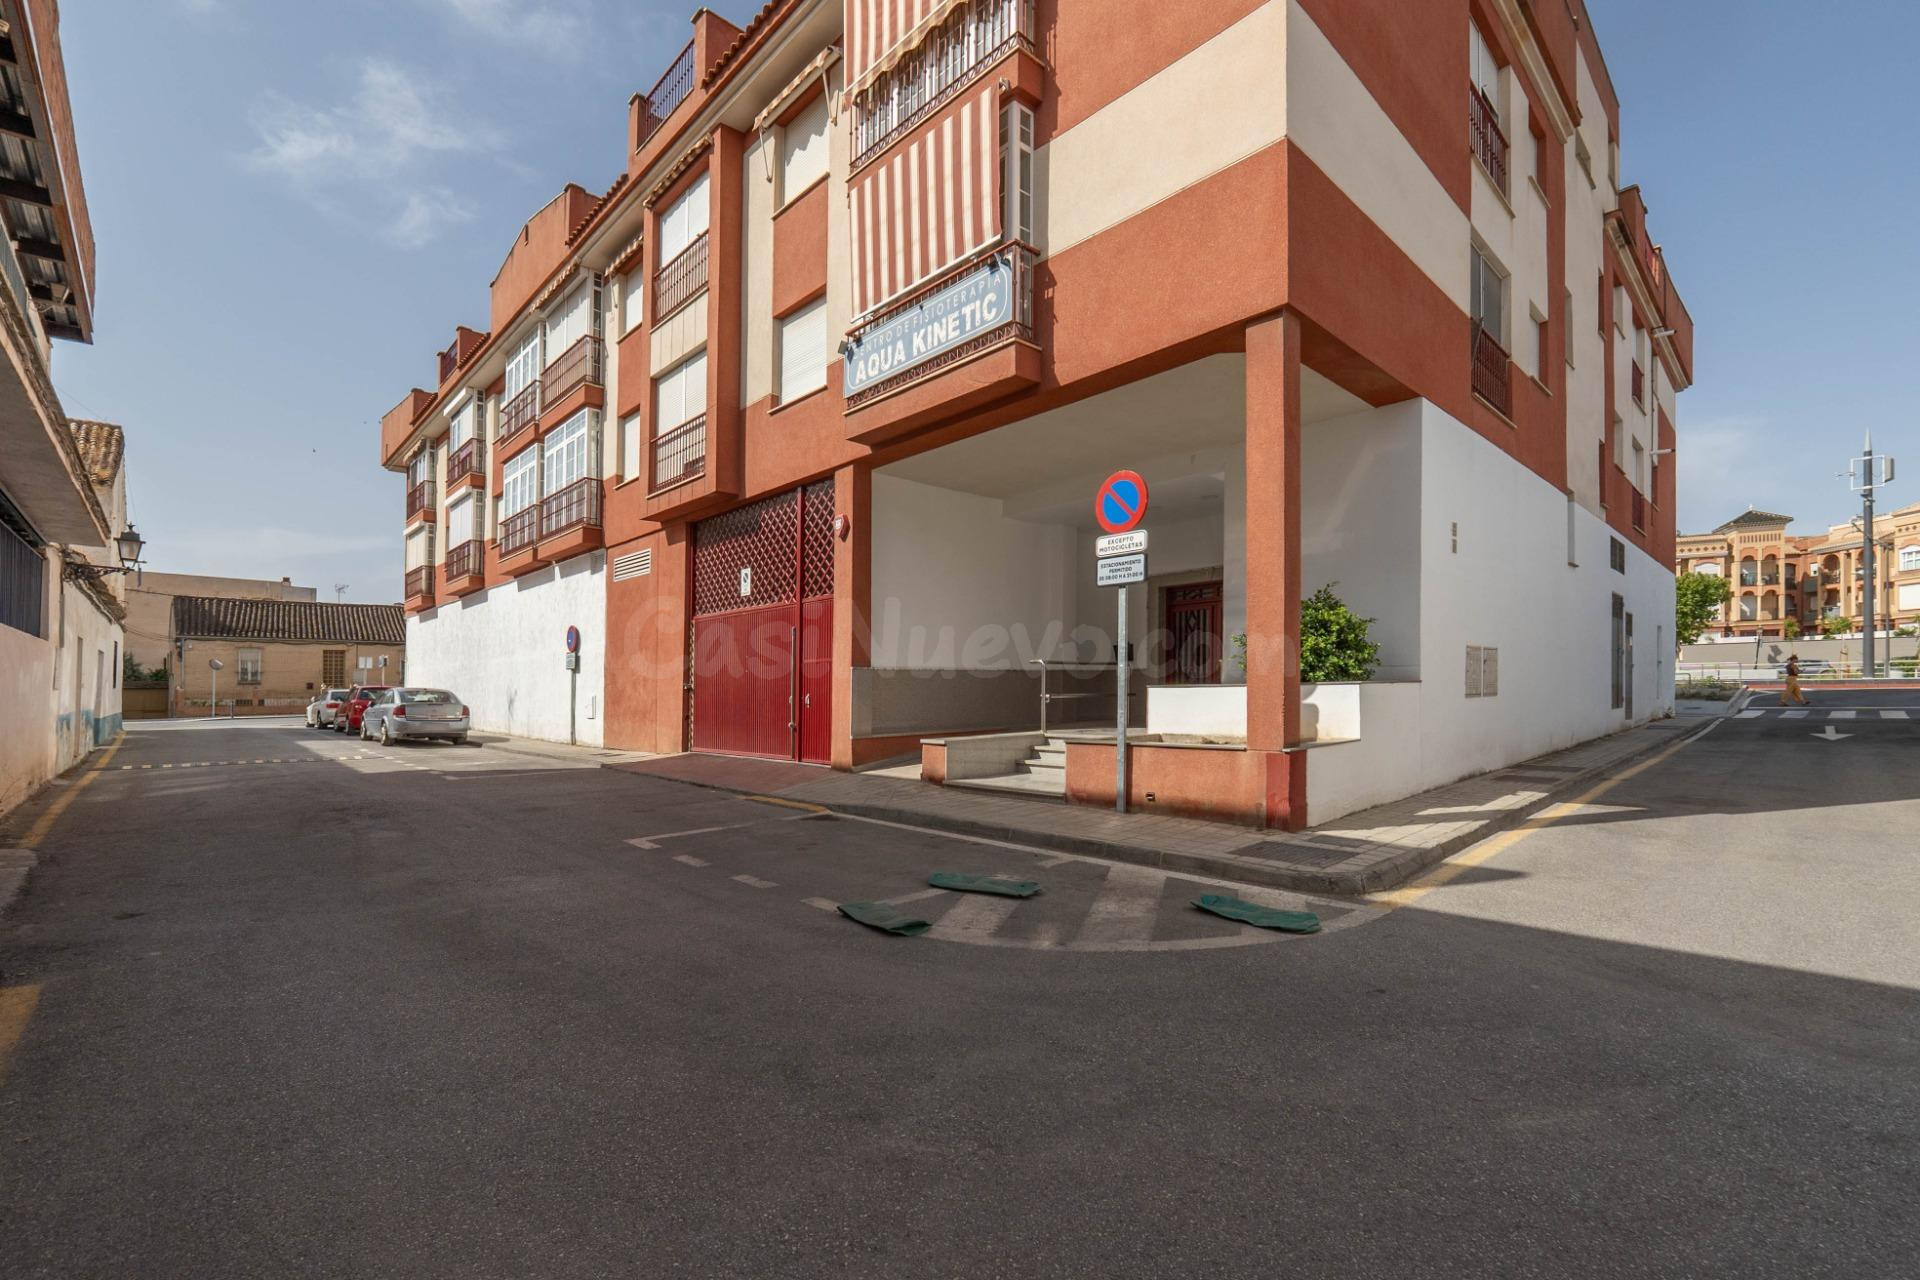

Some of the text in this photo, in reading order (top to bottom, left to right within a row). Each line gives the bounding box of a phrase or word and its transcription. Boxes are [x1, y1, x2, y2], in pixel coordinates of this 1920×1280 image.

[896, 321, 909, 337] DE
[913, 274, 1001, 329] FISIOTERAPIA
[855, 292, 997, 385] AQUA KINETIC
[1107, 536, 1134, 545] EXCEPTO
[1099, 542, 1143, 553] MOTOCICLETAS
[1100, 559, 1142, 569] ESTACIONAMIENTO
